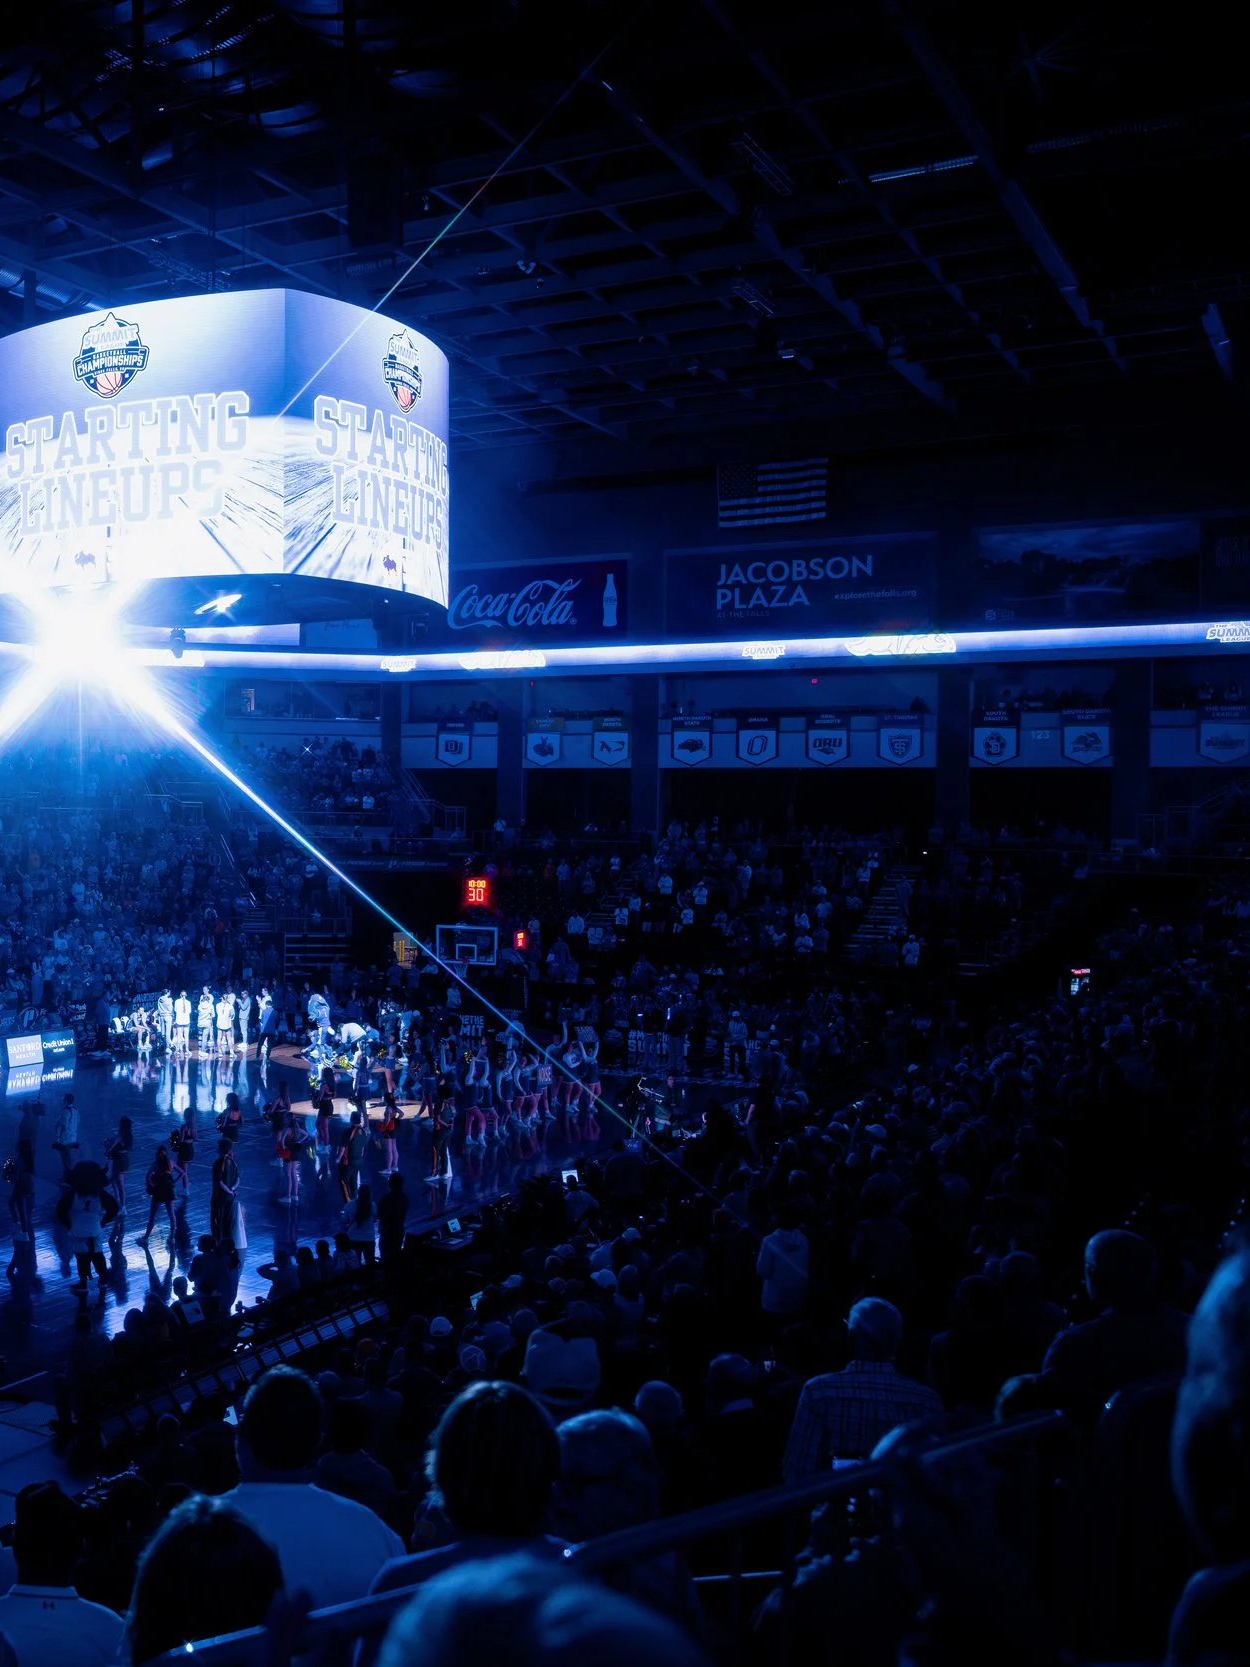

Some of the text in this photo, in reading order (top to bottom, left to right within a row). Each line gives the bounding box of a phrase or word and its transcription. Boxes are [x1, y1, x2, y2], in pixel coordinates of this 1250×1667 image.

[85, 327, 136, 346] SUMMIT
[77, 355, 143, 376] CHAMPIONSHIPS
[6, 391, 250, 478] STARTING
[19, 459, 225, 536] LINEUPS
[331, 463, 445, 551] LINEUPS
[717, 554, 874, 585] JACOBSON
[447, 577, 583, 630] Coca-Cola
[716, 584, 810, 610] PLAZA
[1209, 627, 1250, 638] SUMM
[744, 645, 785, 656] SUMMIT
[1030, 730, 1050, 740] 123
[468, 880, 486, 888] 10:00
[468, 888, 484, 901] 30
[459, 1026, 485, 1036] MIT
[9, 1042, 41, 1054] SANFORD
